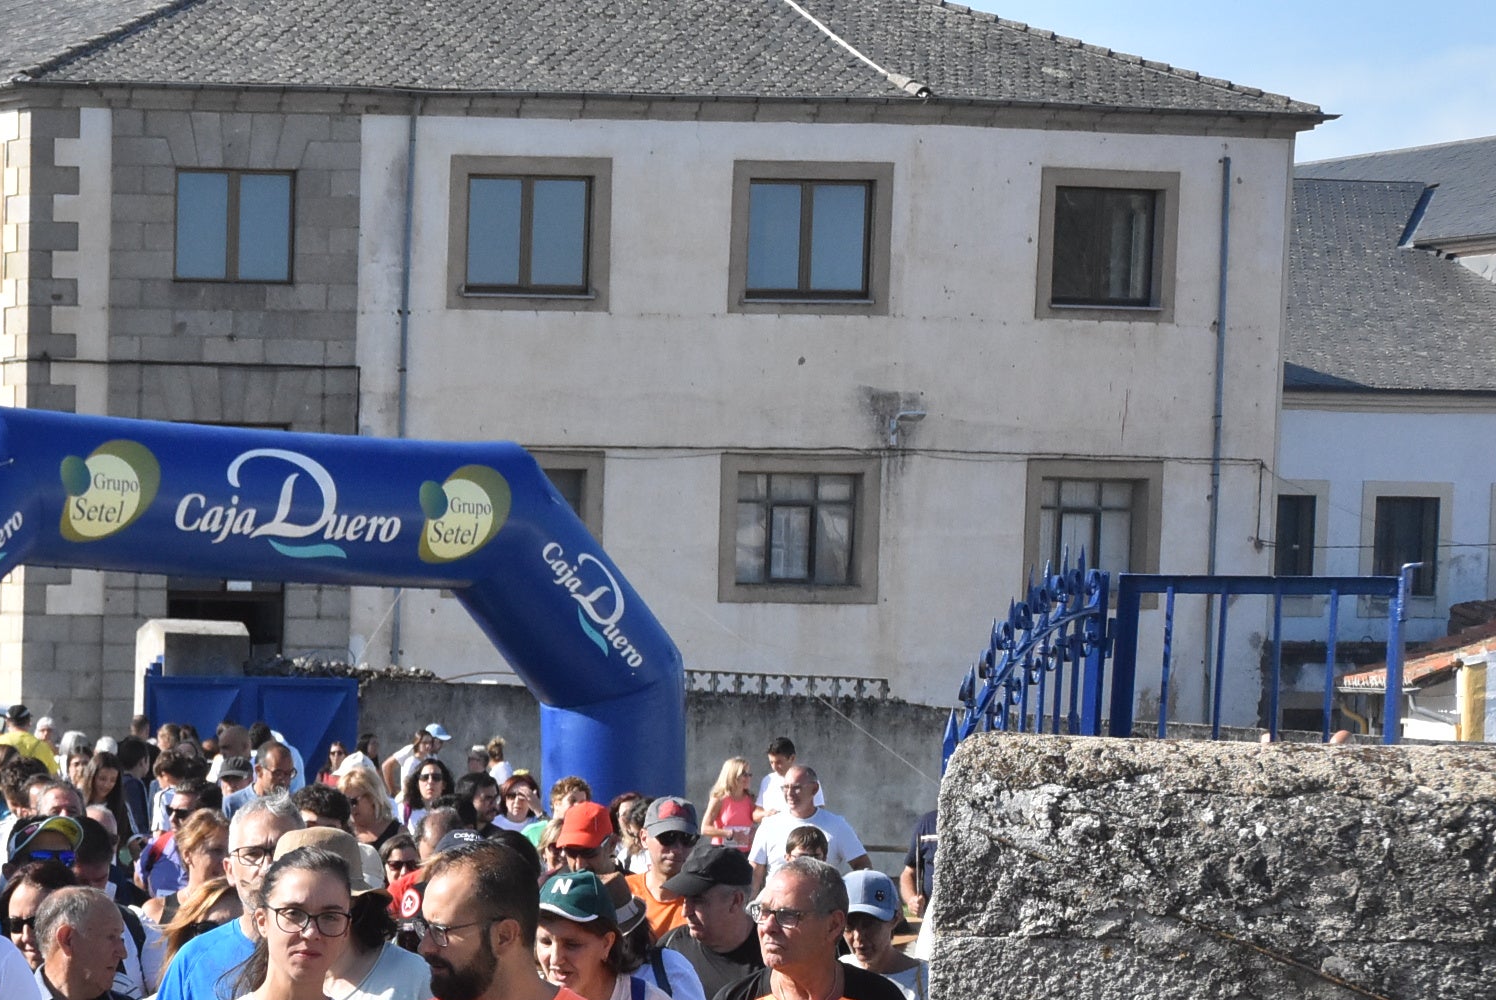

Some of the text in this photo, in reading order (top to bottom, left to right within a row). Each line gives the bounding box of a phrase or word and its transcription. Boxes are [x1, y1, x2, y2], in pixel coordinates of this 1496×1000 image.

[93, 471, 139, 497] Grupo
[175, 448, 401, 544] Caja Duero
[71, 497, 125, 524] Setel
[450, 496, 492, 519] Grupo
[429, 521, 479, 545] Setel
[542, 542, 643, 668] Caja Duero
[551, 878, 572, 895] N
